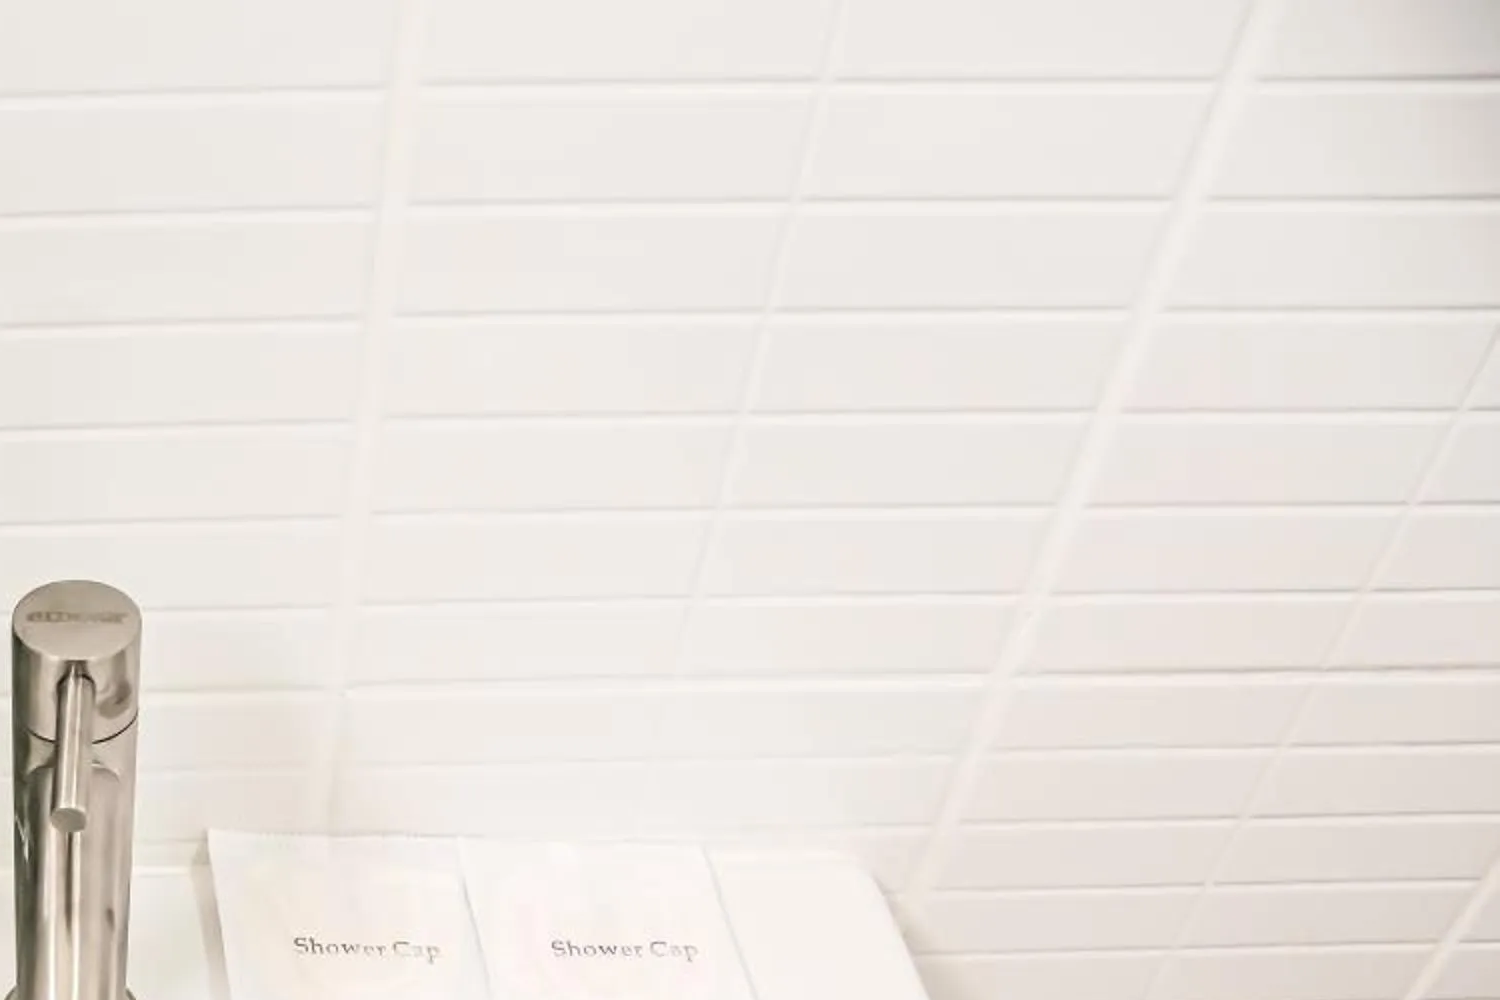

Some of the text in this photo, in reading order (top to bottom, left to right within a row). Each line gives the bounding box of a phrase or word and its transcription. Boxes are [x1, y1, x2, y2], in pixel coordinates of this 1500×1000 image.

[293, 936, 442, 965] Shower Cap
[551, 940, 699, 963] Shower Cap
